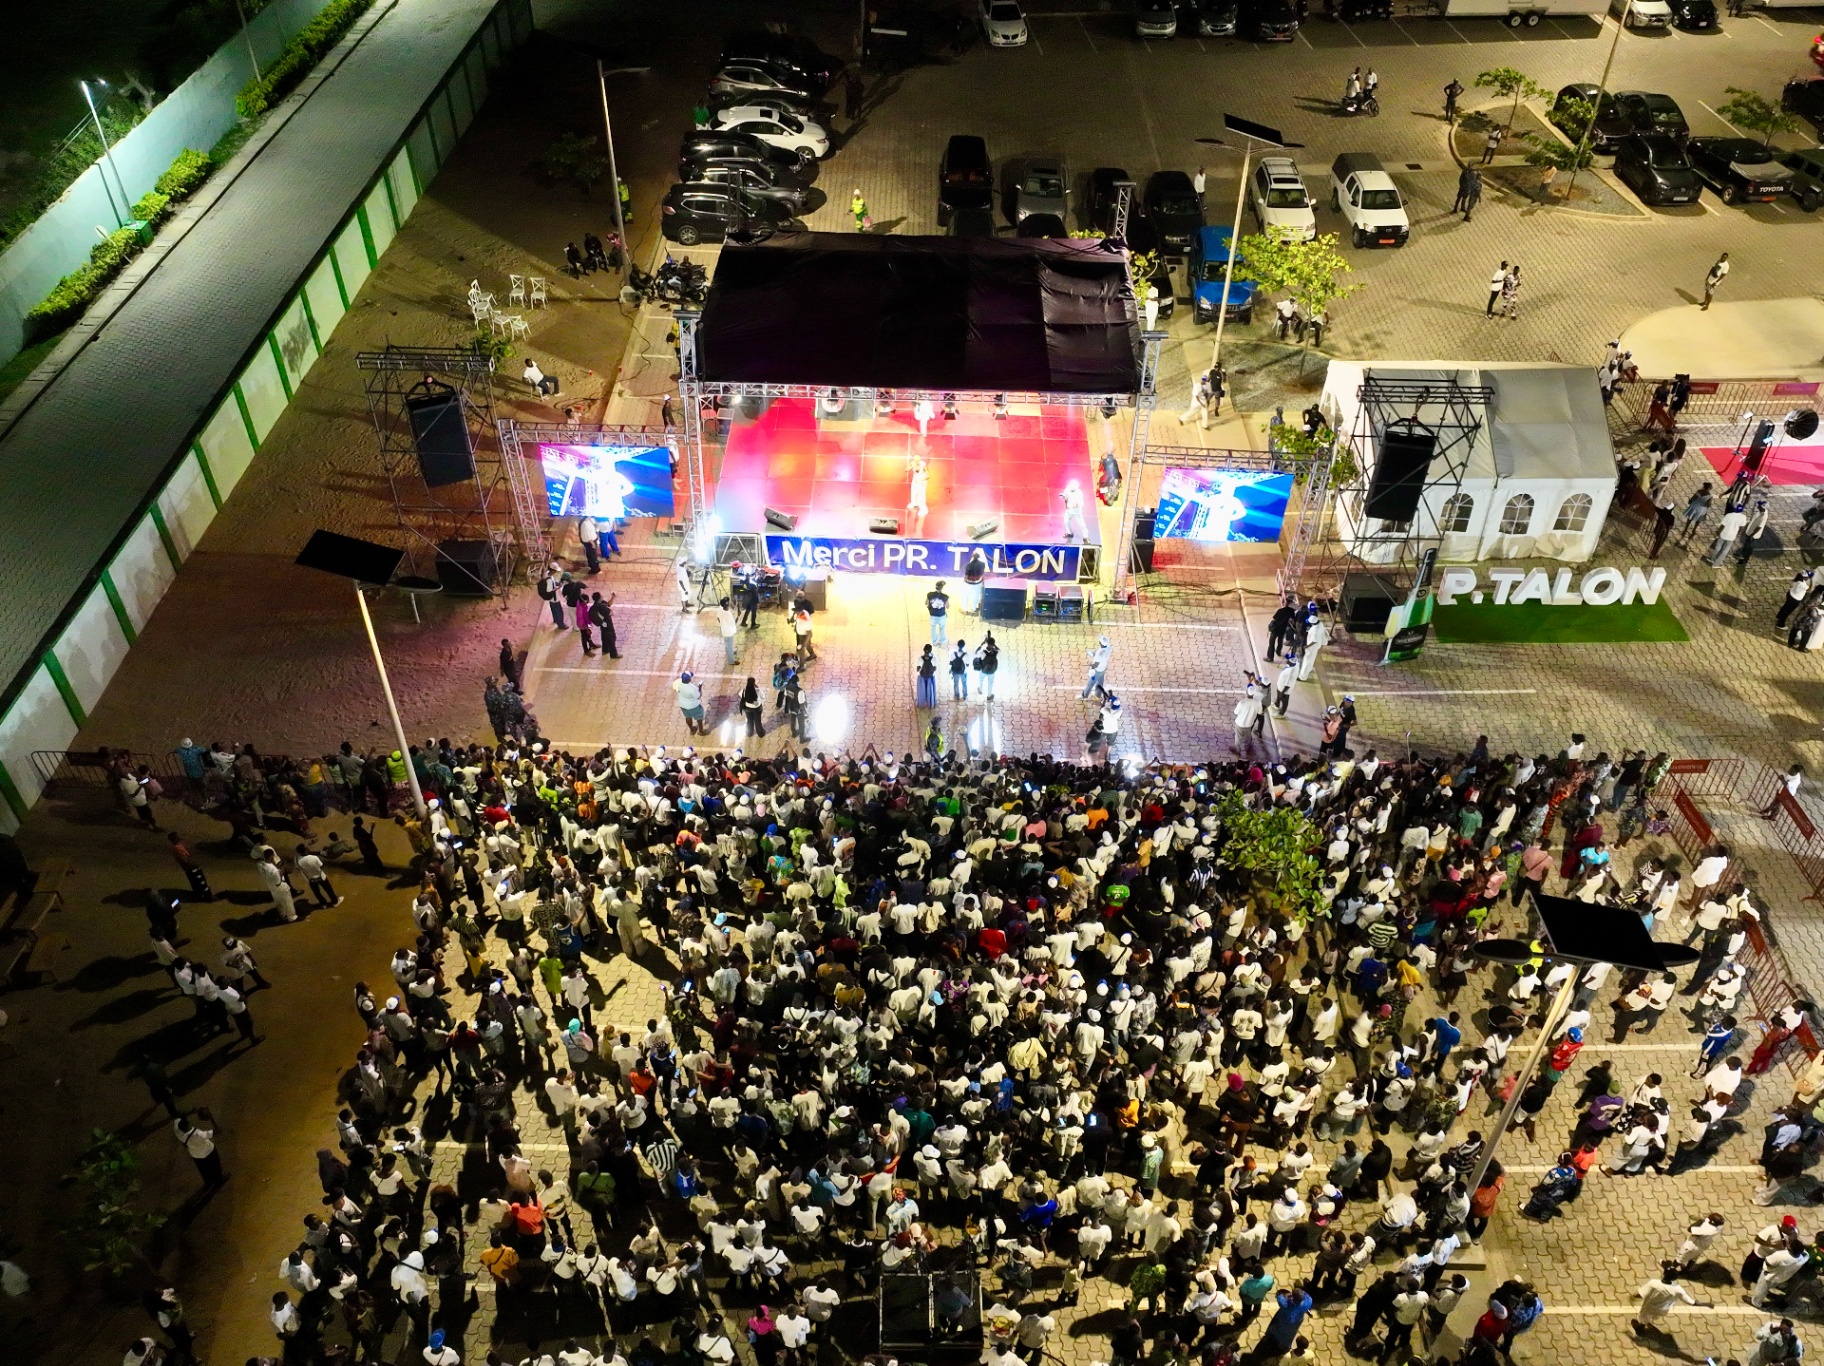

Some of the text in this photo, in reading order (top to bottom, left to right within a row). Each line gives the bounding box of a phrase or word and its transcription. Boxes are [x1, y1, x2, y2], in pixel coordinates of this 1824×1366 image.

[781, 540, 1065, 574] Merci PR. TALON
